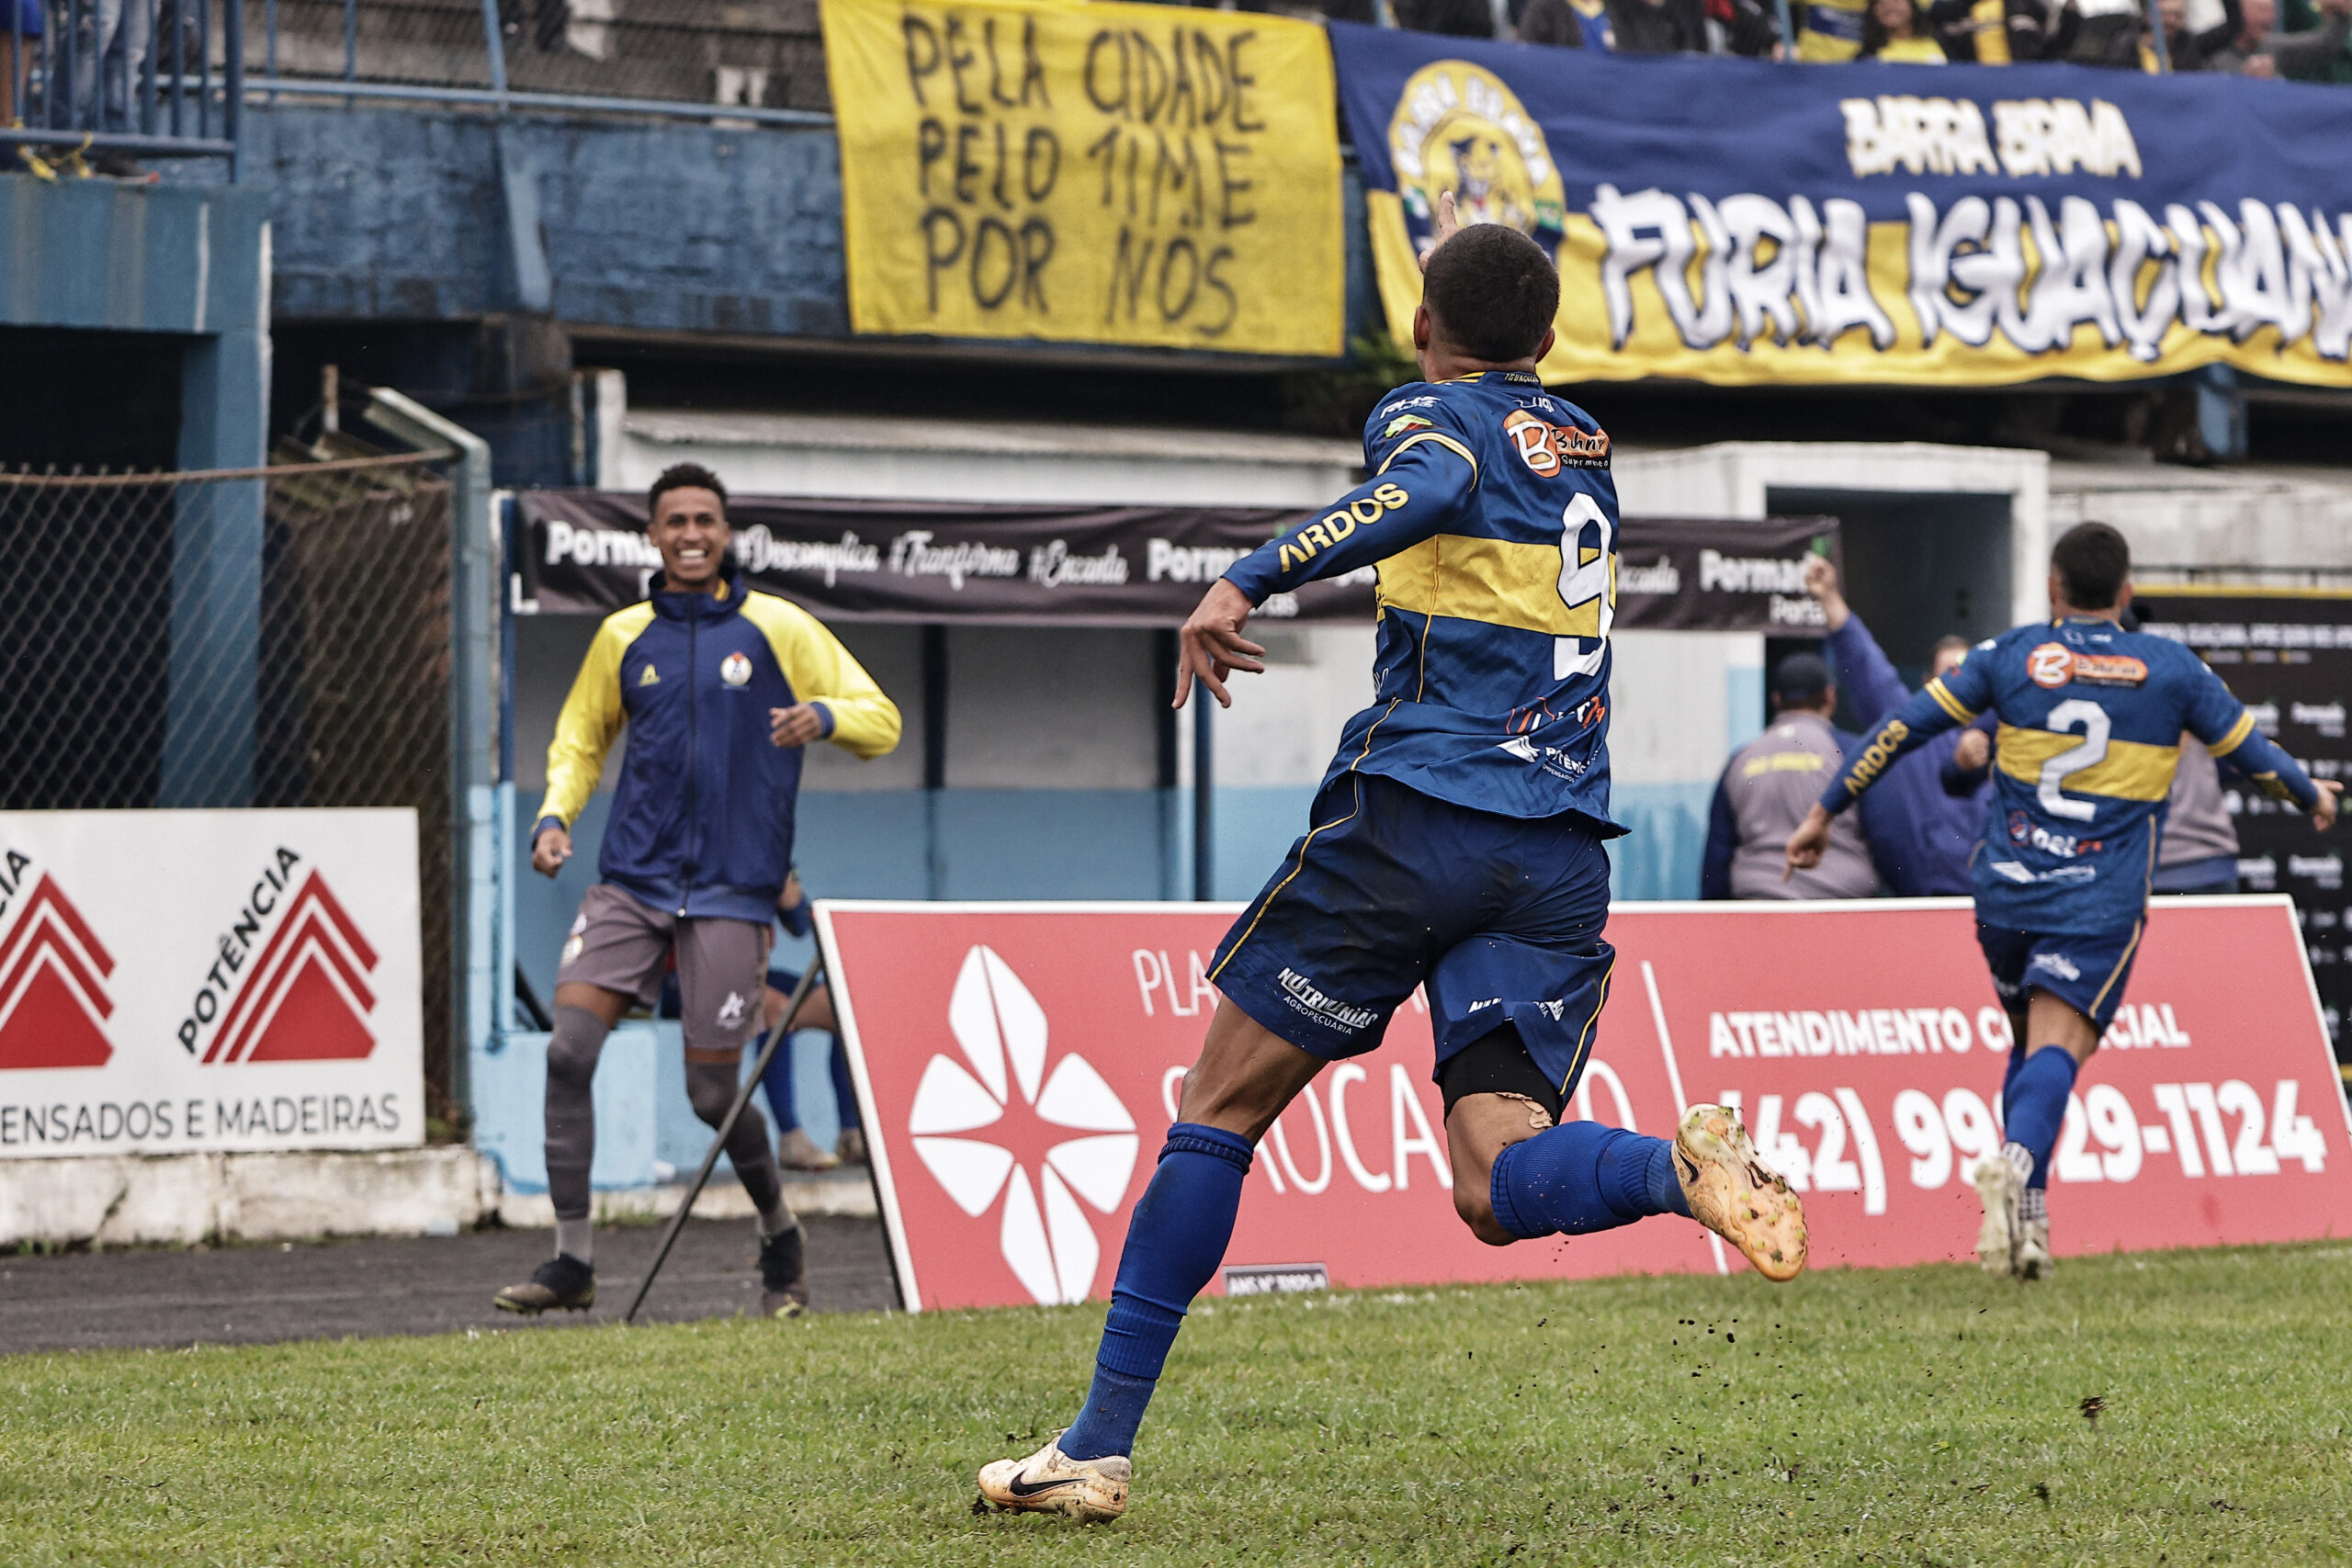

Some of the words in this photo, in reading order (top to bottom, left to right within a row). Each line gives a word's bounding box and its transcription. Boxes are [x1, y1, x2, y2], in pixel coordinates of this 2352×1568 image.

[903, 13, 1051, 115] PELA
[1083, 26, 1266, 133] CIDADE
[920, 116, 1061, 211] PELO
[1087, 125, 1257, 230] TIME
[1839, 94, 1999, 180] BARRA
[1991, 96, 2143, 180] BRAVA
[922, 205, 1057, 315] POR
[1105, 224, 1238, 338] NOS
[1588, 182, 1897, 354] FURIA
[545, 520, 665, 567] Porma
[1147, 536, 1255, 583] Porm
[1700, 547, 1813, 593] Pormad
[1554, 491, 1613, 682] 9
[2036, 699, 2111, 822] 2
[177, 844, 300, 1055] POTÊNCIA
[1131, 947, 1219, 1017] PLA
[1283, 995, 1352, 1035] AGROPECUÁRIA
[1708, 1006, 1973, 1057] ATENDIMENTO
[1976, 1001, 2191, 1054] CCIAL
[0, 1100, 174, 1145] ENSADOS
[186, 1100, 206, 1139] E
[216, 1092, 401, 1137] MADEIRAS
[1718, 1087, 1887, 1215] 42)
[1892, 1078, 2327, 1190] 9929-1124
